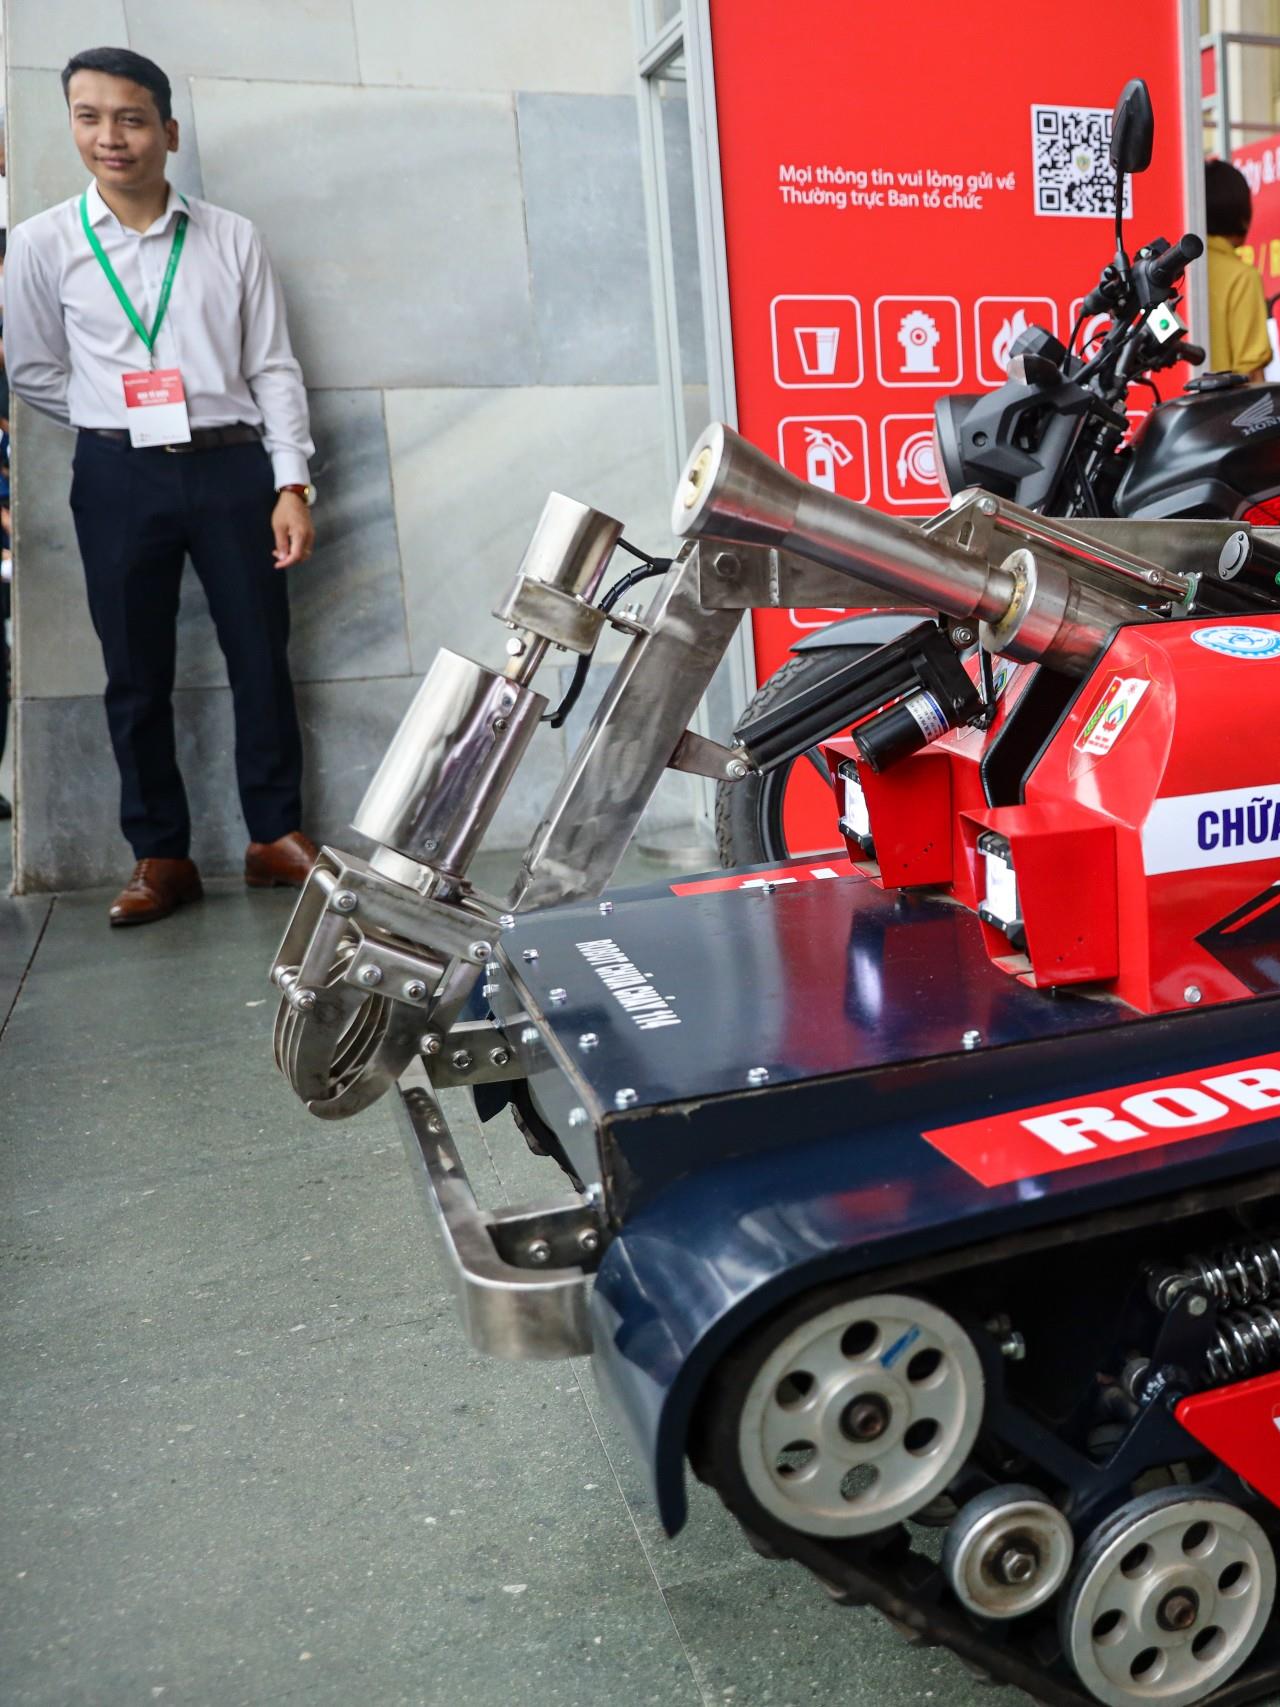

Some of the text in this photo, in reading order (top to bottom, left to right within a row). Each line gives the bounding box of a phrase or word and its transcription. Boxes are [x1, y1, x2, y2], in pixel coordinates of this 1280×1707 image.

[779, 165, 1016, 194] Mọi thông tin vui lòng gửi về
[1262, 149, 1273, 184] &
[779, 186, 847, 209] Thường
[851, 189, 884, 209] trực
[888, 190, 919, 207] Ban
[943, 190, 983, 209] chức
